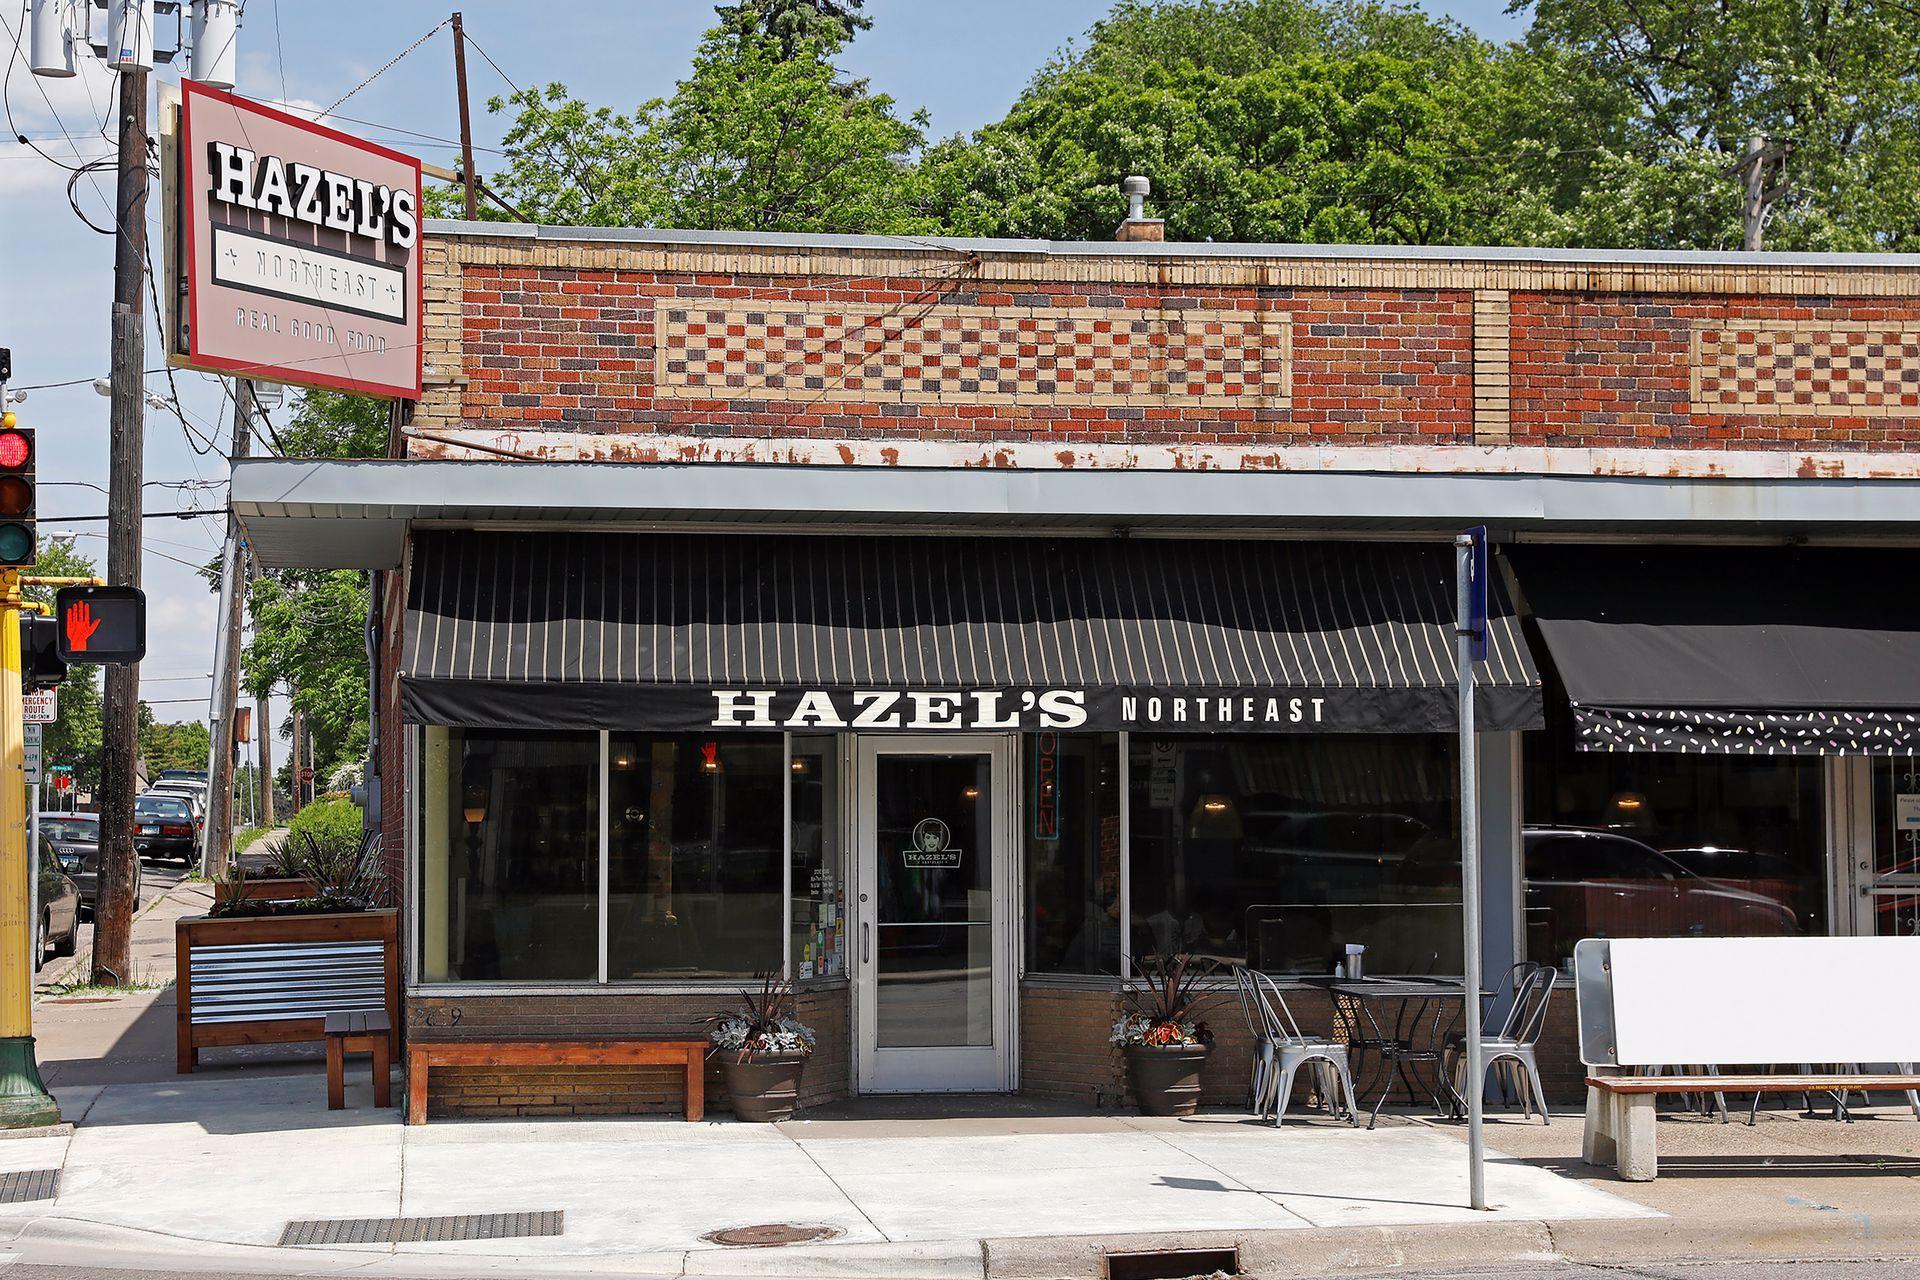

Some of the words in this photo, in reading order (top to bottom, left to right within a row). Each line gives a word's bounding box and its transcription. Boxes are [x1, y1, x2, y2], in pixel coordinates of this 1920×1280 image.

[207, 141, 417, 249] HAZEL'S
[256, 250, 377, 300] NORTHEAST
[237, 307, 281, 334] REAL
[291, 318, 335, 345] GOOD
[347, 330, 386, 355] FOOD
[22, 696, 53, 705] MERGENCY
[24, 705, 45, 714] ROUTE
[711, 690, 1088, 728] HAZEL'S
[1122, 697, 1325, 722] NORTHEAST
